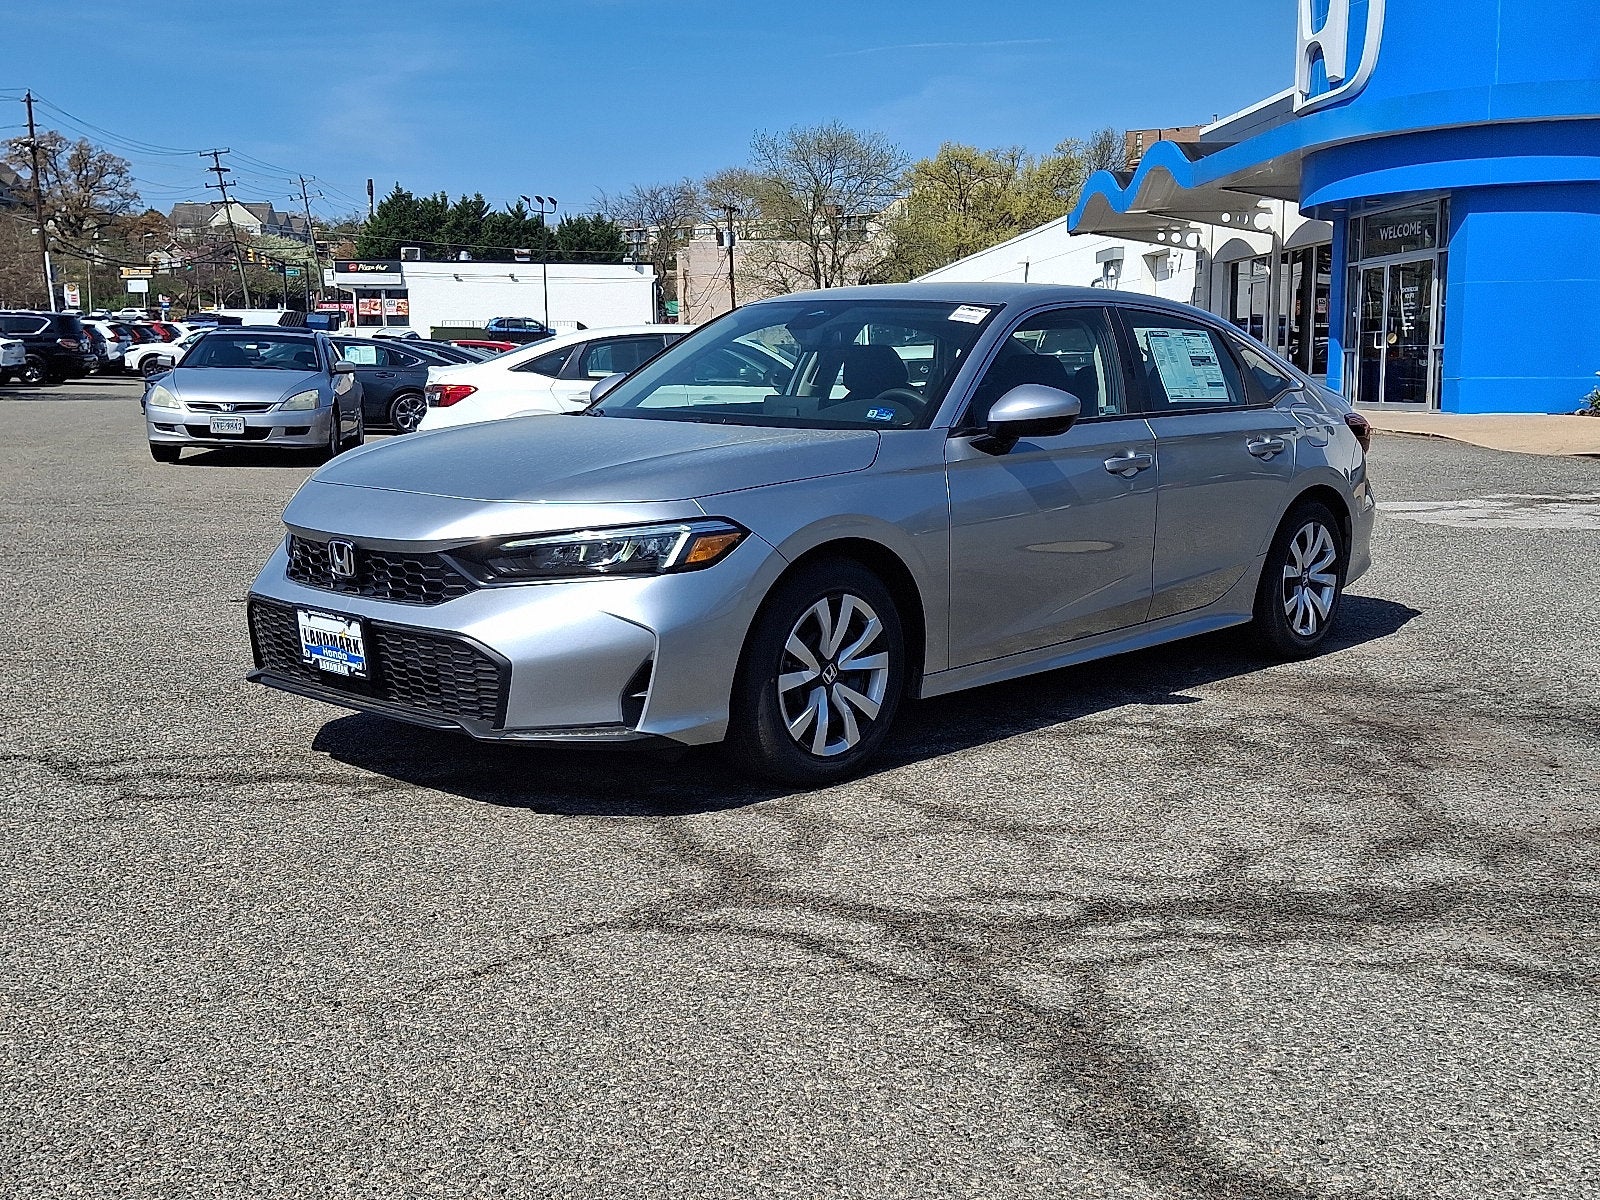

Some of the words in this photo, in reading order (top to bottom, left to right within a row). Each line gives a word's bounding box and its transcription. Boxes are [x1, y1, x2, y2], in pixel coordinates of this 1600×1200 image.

[1379, 220, 1422, 241] WELCOME
[358, 263, 375, 271] Pizza
[375, 263, 389, 271] Hut
[303, 627, 361, 655] LANDMARK
[322, 647, 348, 661] Honda
